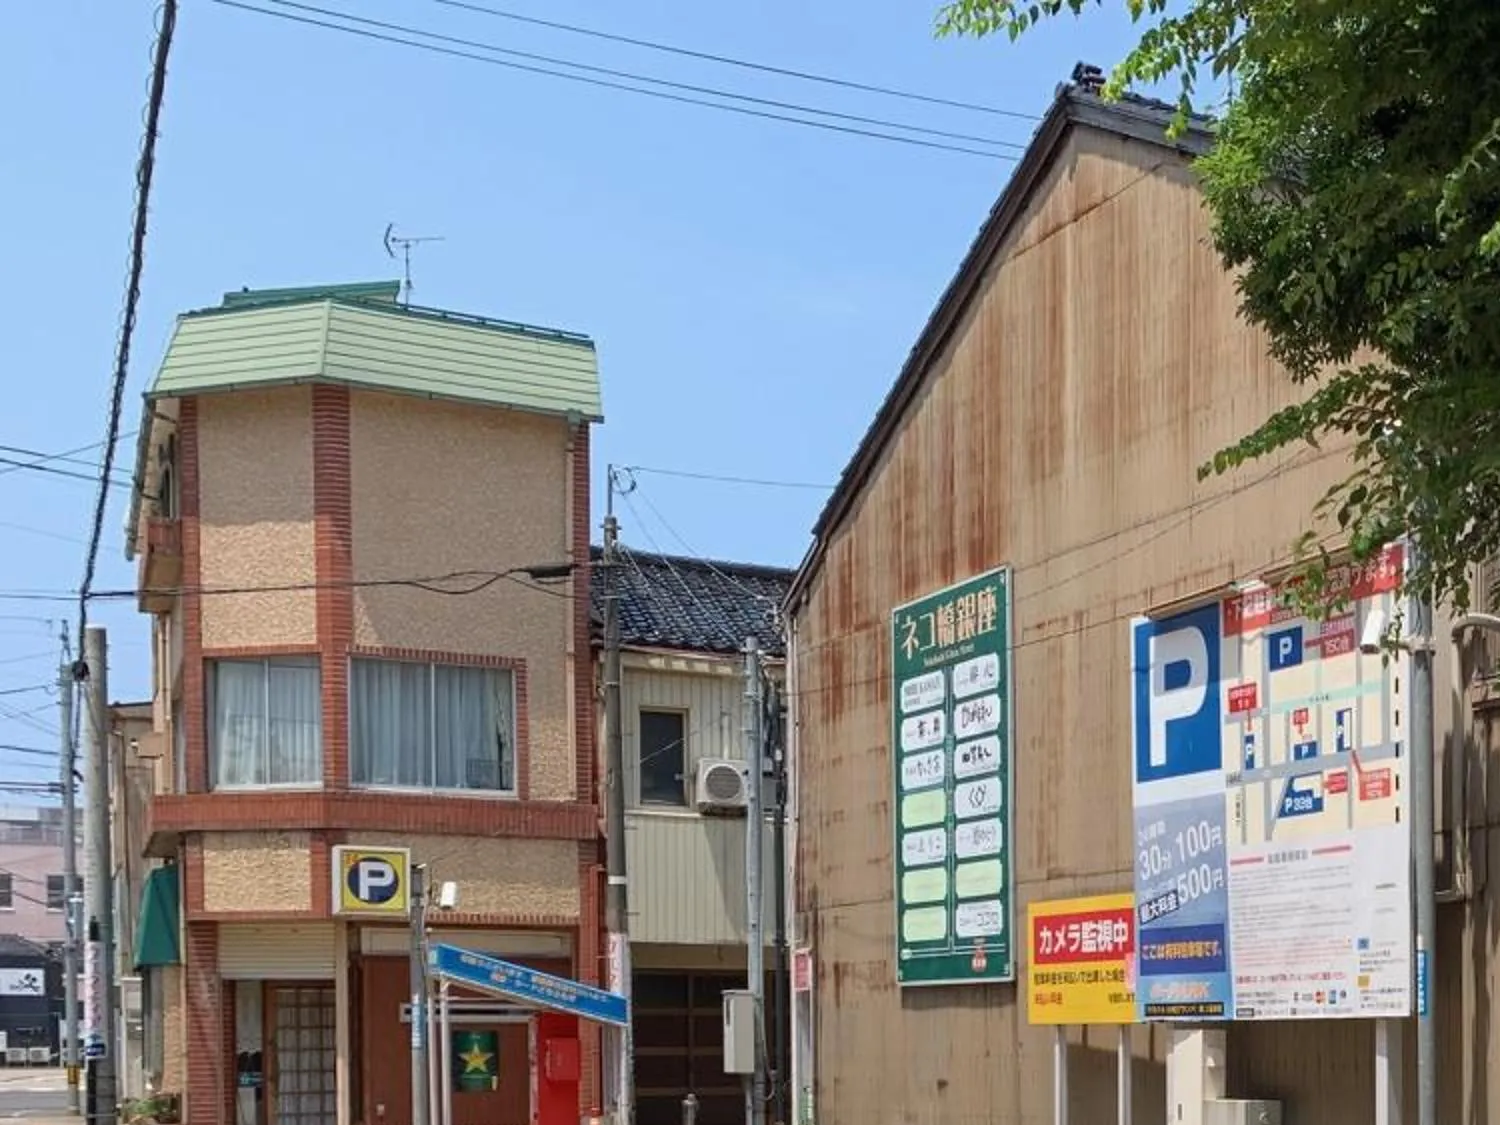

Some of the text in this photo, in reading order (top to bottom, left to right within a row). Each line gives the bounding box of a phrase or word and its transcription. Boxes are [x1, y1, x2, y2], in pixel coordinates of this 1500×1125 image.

[1278, 636, 1292, 664] P
[1149, 626, 1209, 767] P
[1175, 819, 1224, 864] 100円
[359, 861, 395, 900] P
[1176, 863, 1225, 905] 500円
[1038, 917, 1129, 955] カメラ監視中
